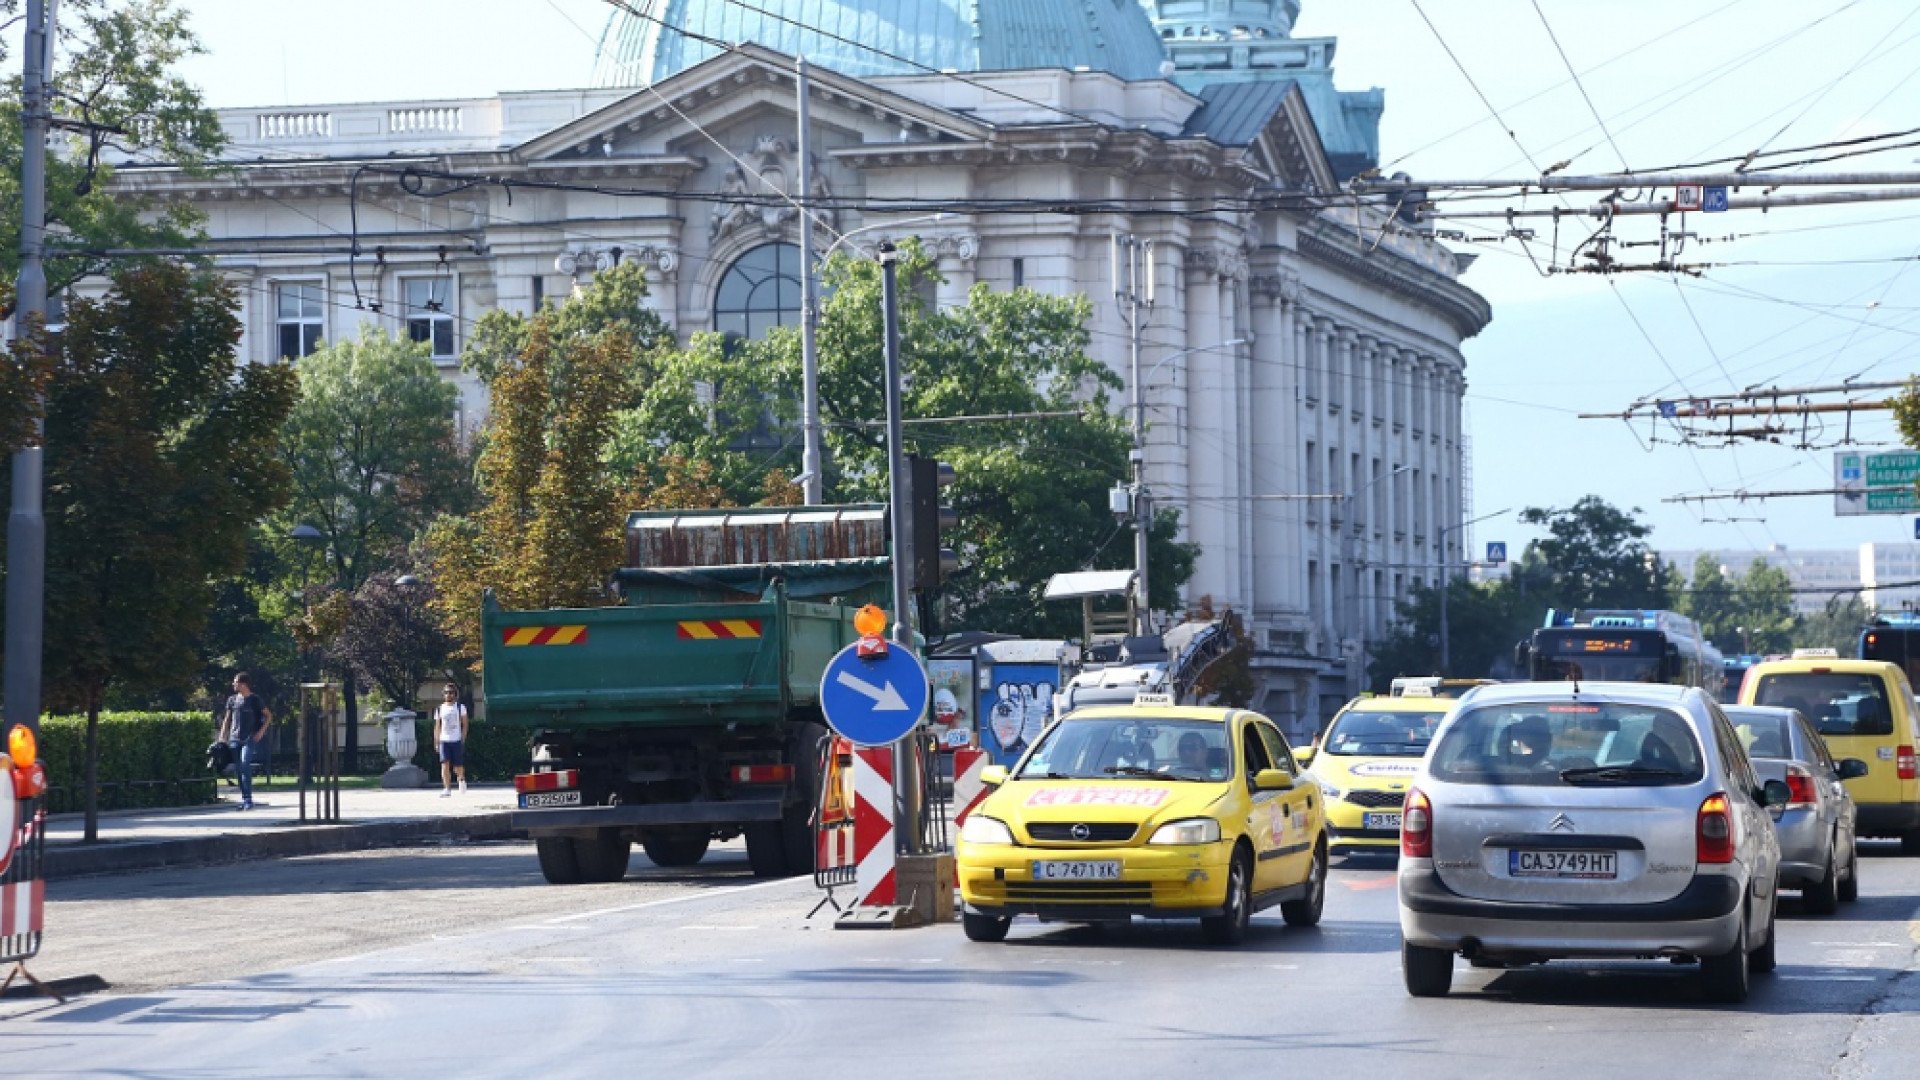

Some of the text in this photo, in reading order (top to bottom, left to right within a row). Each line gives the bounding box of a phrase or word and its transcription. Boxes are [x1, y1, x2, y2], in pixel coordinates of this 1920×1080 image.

[1061, 862, 1096, 878] 7471
[1520, 852, 1614, 872] CA 3749 HT
